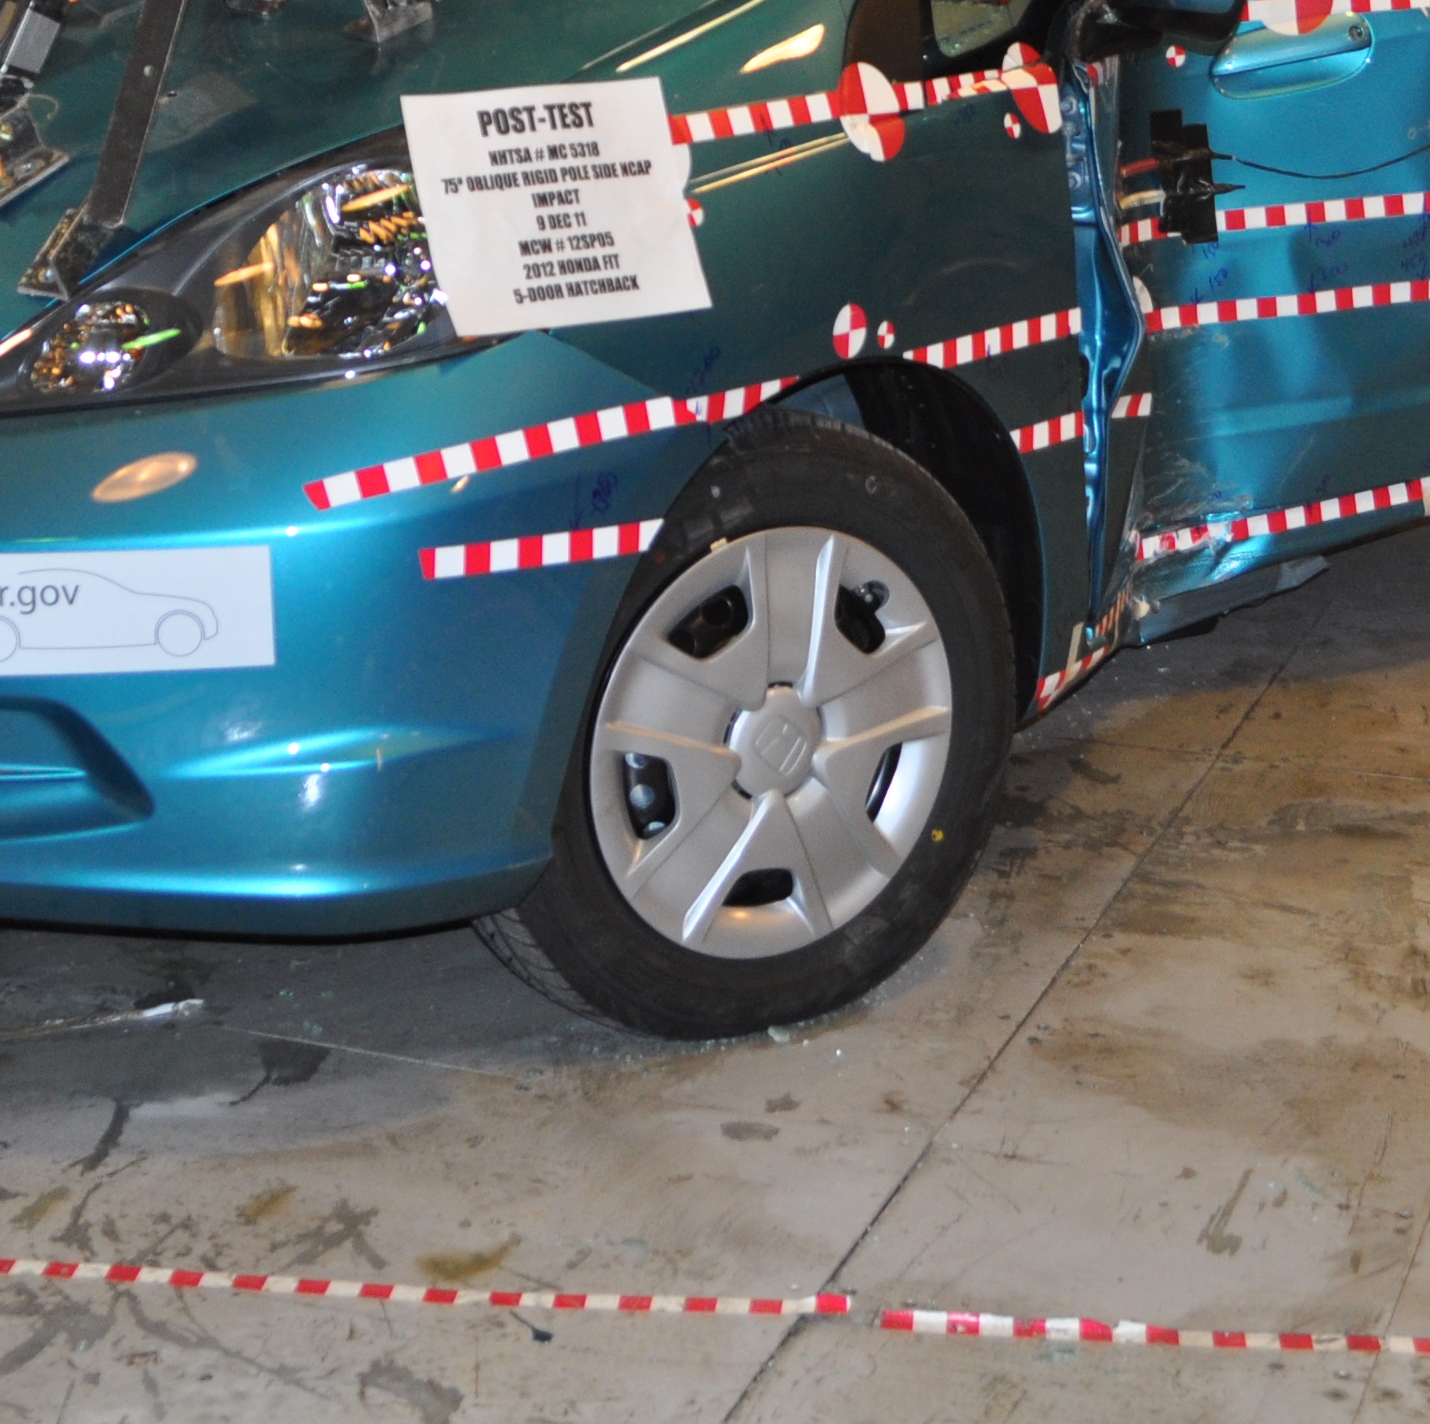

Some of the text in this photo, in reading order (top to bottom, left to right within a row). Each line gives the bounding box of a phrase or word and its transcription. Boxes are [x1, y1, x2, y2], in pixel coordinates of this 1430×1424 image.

[477, 102, 594, 137] POST-TEST
[488, 141, 600, 167] NHTSA # MC 5318
[466, 175, 520, 192] OBLIQUE
[521, 168, 559, 186] RIGID
[560, 165, 589, 182] POLE
[591, 162, 618, 180] SIDE
[619, 159, 652, 177] NCAP
[531, 188, 580, 208] IMPACT
[536, 211, 587, 231] 9 DEC 11
[518, 231, 615, 257] MCW # 12SP05
[523, 253, 620, 280] 2012 HONDA FIT
[513, 275, 640, 304] 5-DOOR HATCHBACK
